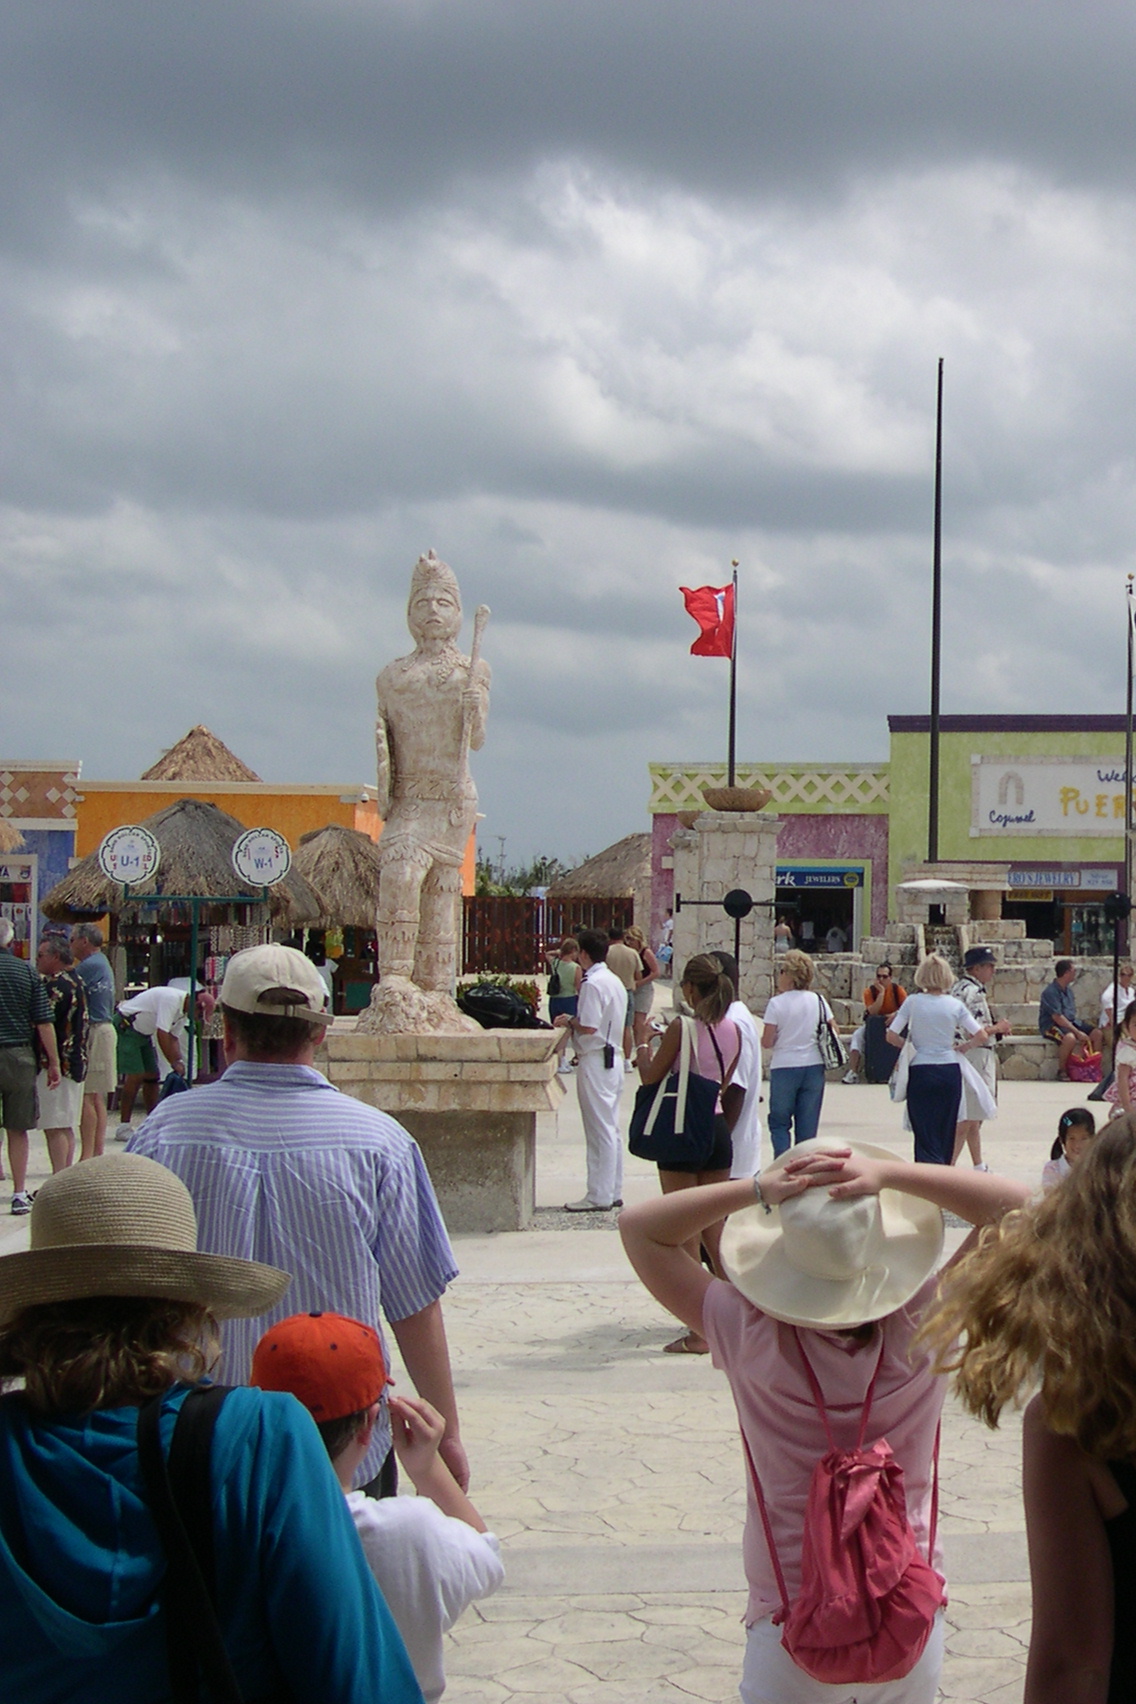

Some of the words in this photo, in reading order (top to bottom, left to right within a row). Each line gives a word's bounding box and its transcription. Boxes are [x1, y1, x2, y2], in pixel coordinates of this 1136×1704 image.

[121, 855, 139, 867] U-1
[254, 857, 272, 869] W-1
[776, 871, 796, 887] rk
[1035, 871, 1074, 885] JEWELRY
